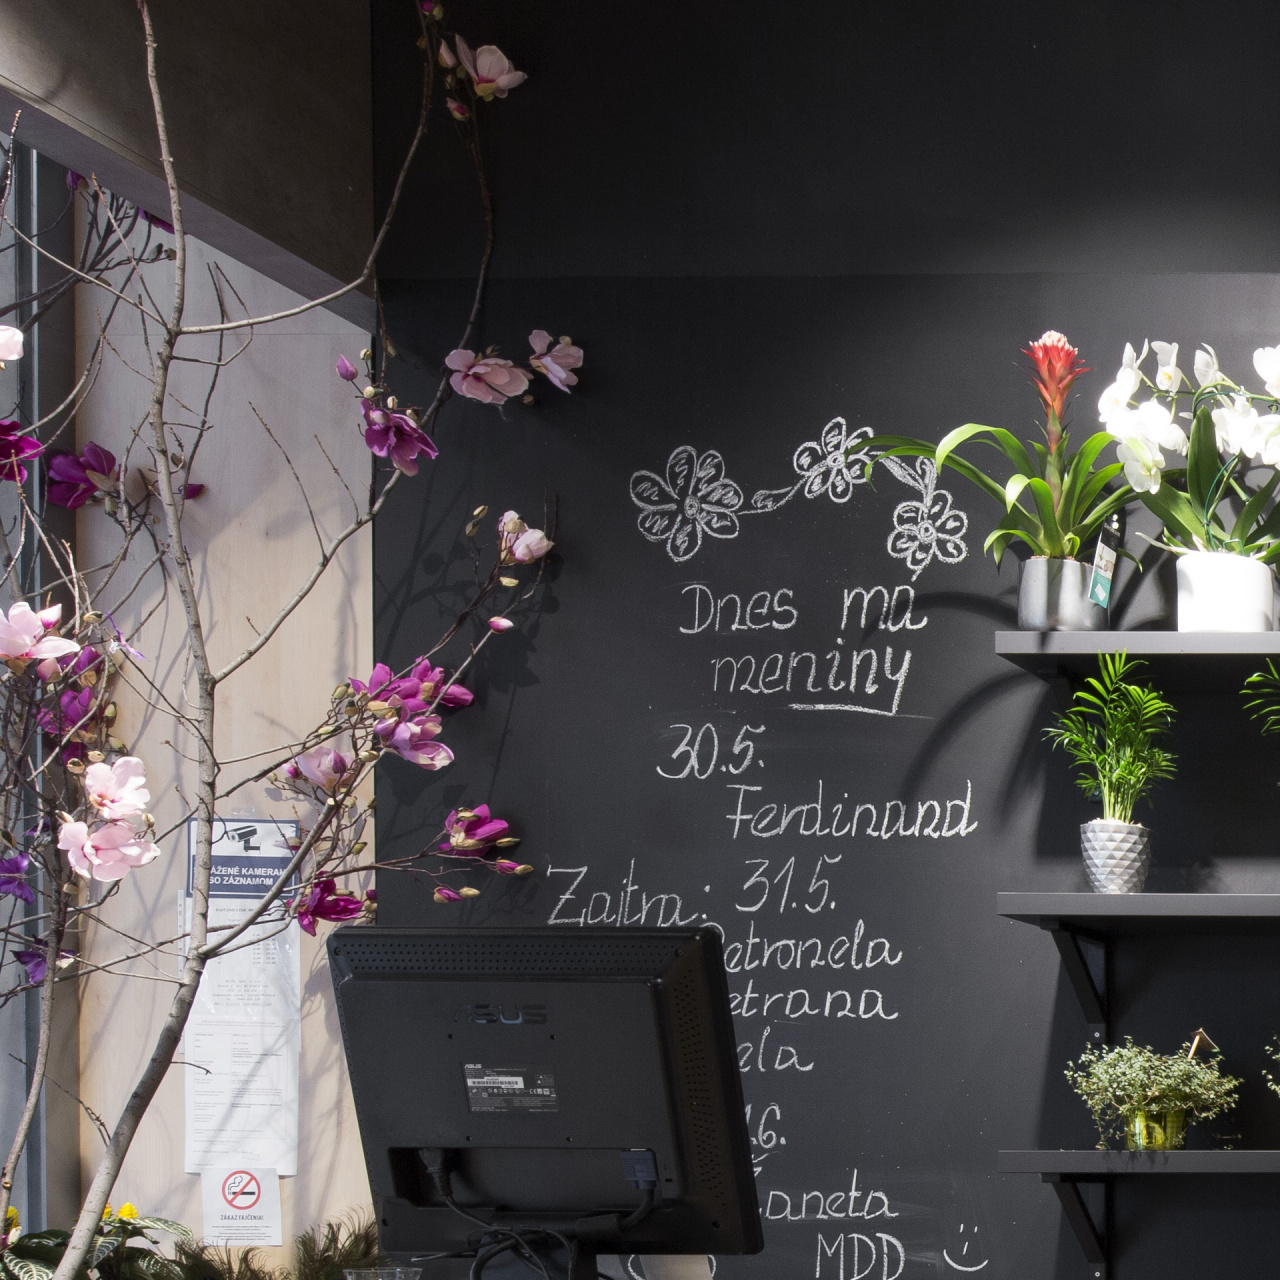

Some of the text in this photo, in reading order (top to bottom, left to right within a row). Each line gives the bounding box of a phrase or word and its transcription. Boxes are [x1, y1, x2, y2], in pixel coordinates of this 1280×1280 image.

[680, 585, 799, 634] Dnes
[711, 639, 912, 715] meniny
[656, 724, 766, 780] 30.5.
[726, 780, 978, 839] Ferdinand
[209, 876, 273, 886] SO ZÁZNAMOM
[736, 855, 842, 914] 31.5.
[239, 1213, 264, 1221] FAJČENIA!
